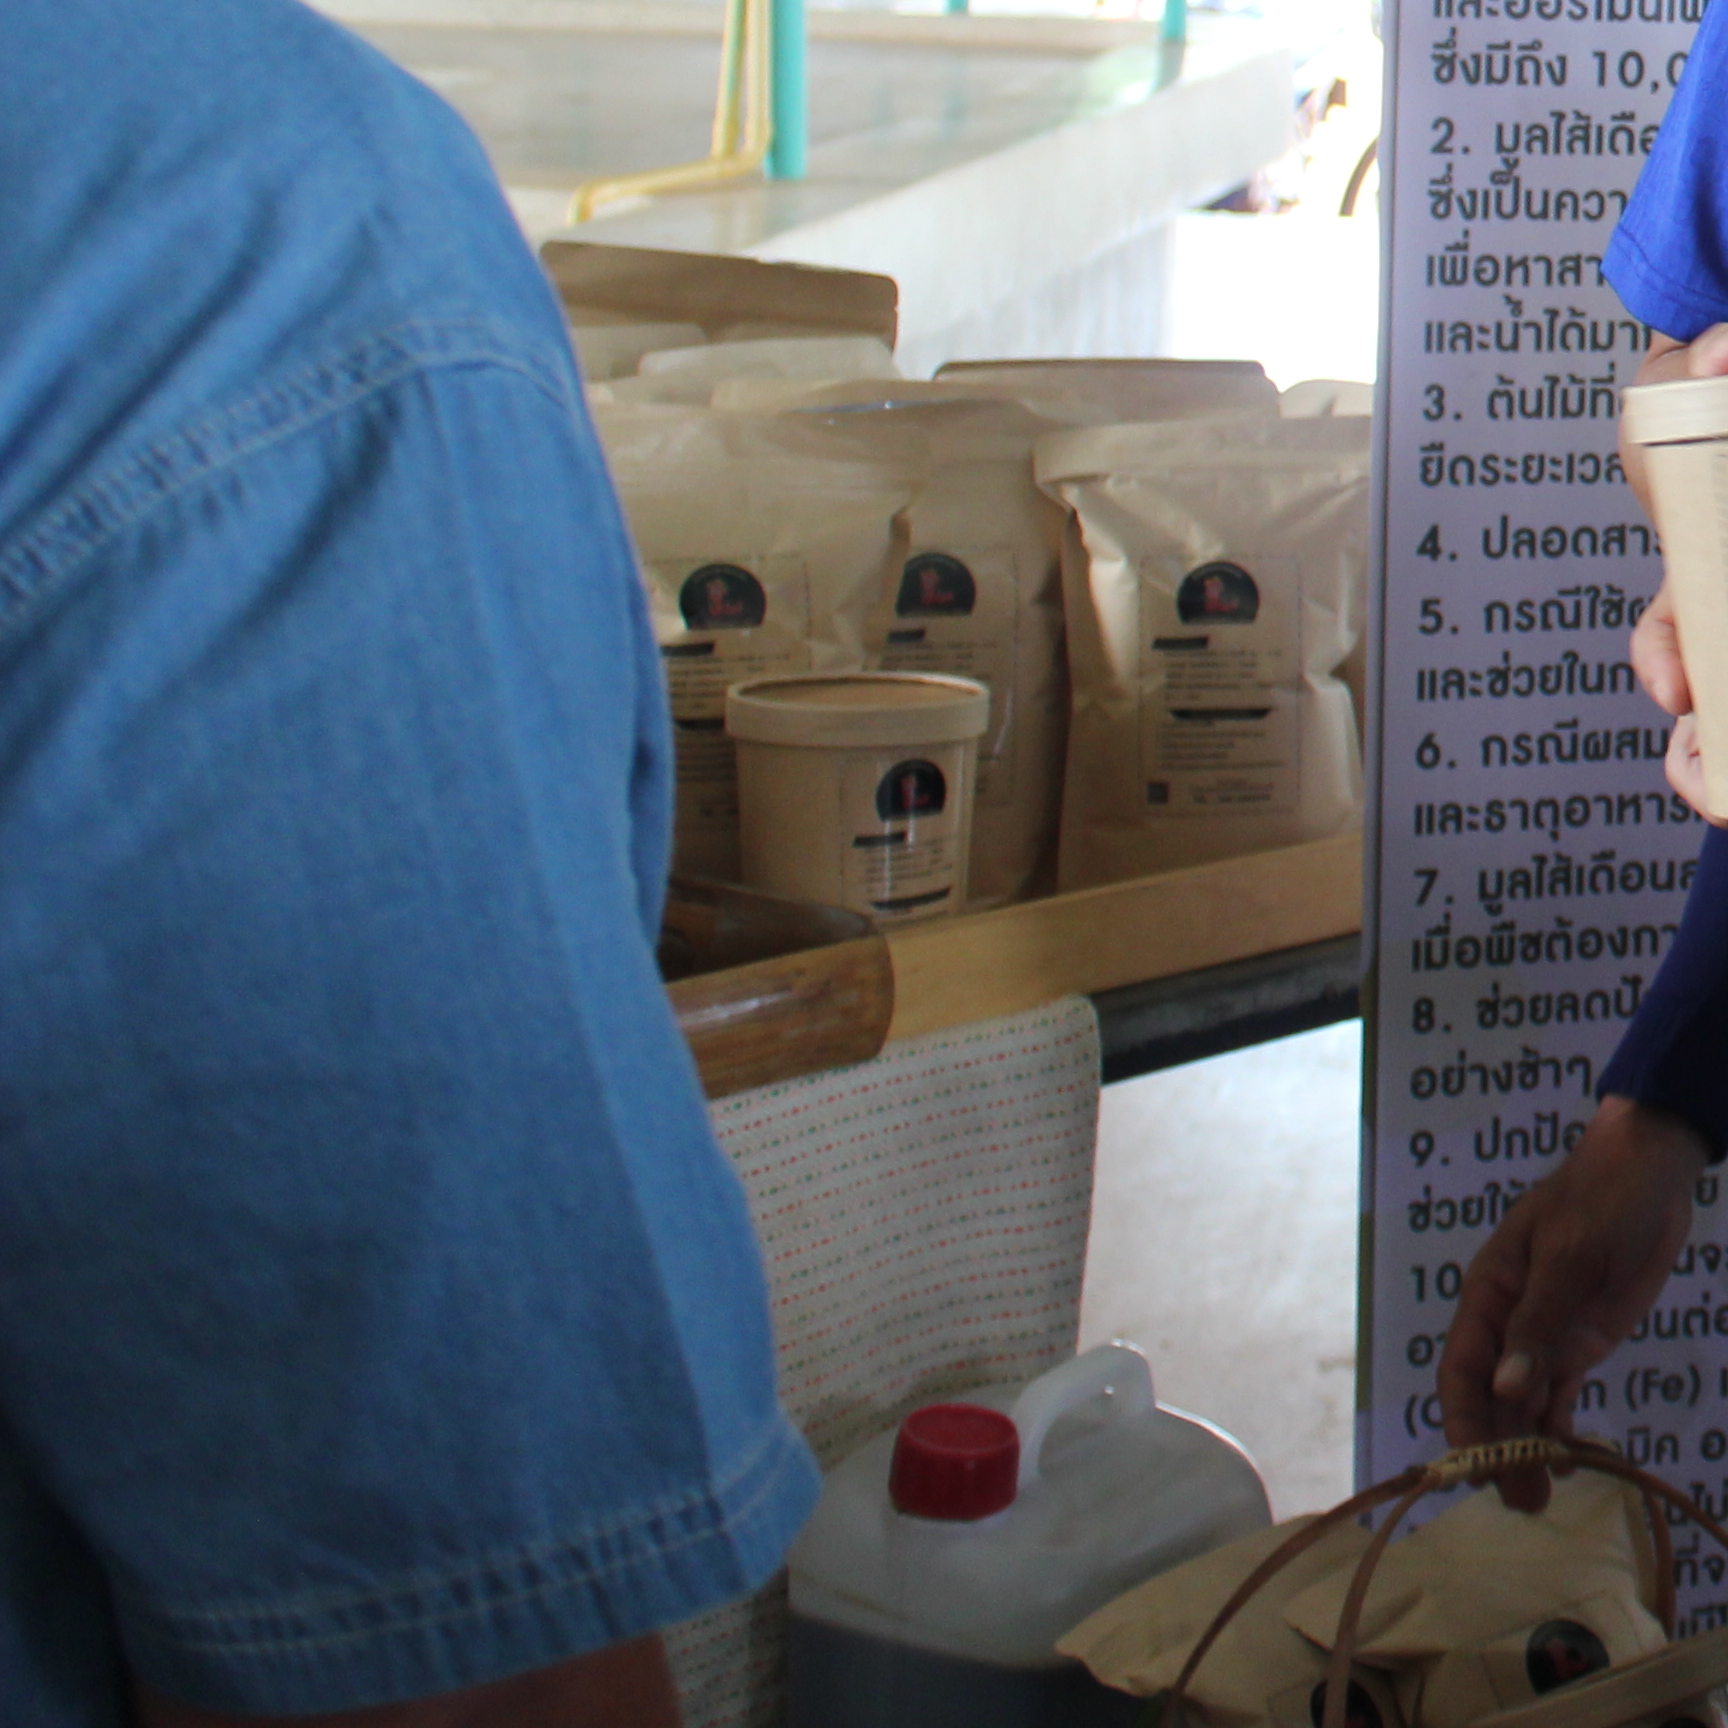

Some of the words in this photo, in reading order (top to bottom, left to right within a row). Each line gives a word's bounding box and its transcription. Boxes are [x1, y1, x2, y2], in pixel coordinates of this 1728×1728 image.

[1430, 28, 1569, 88] ซึ่งมีถึง
[1429, 116, 1471, 156] 2.
[1421, 383, 1462, 422] 3.
[1486, 362, 1625, 421] ต้นไม้ที่
[1416, 524, 1459, 563] 4.
[1418, 598, 1460, 636] 5.
[1415, 732, 1458, 772] 6.
[1414, 791, 1701, 842] และธาตุอาหาร
[1413, 868, 1456, 908] 7.
[1411, 996, 1453, 1035] 8.
[1408, 1130, 1450, 1167] 9.
[1625, 1363, 1701, 1411] (Fe)
